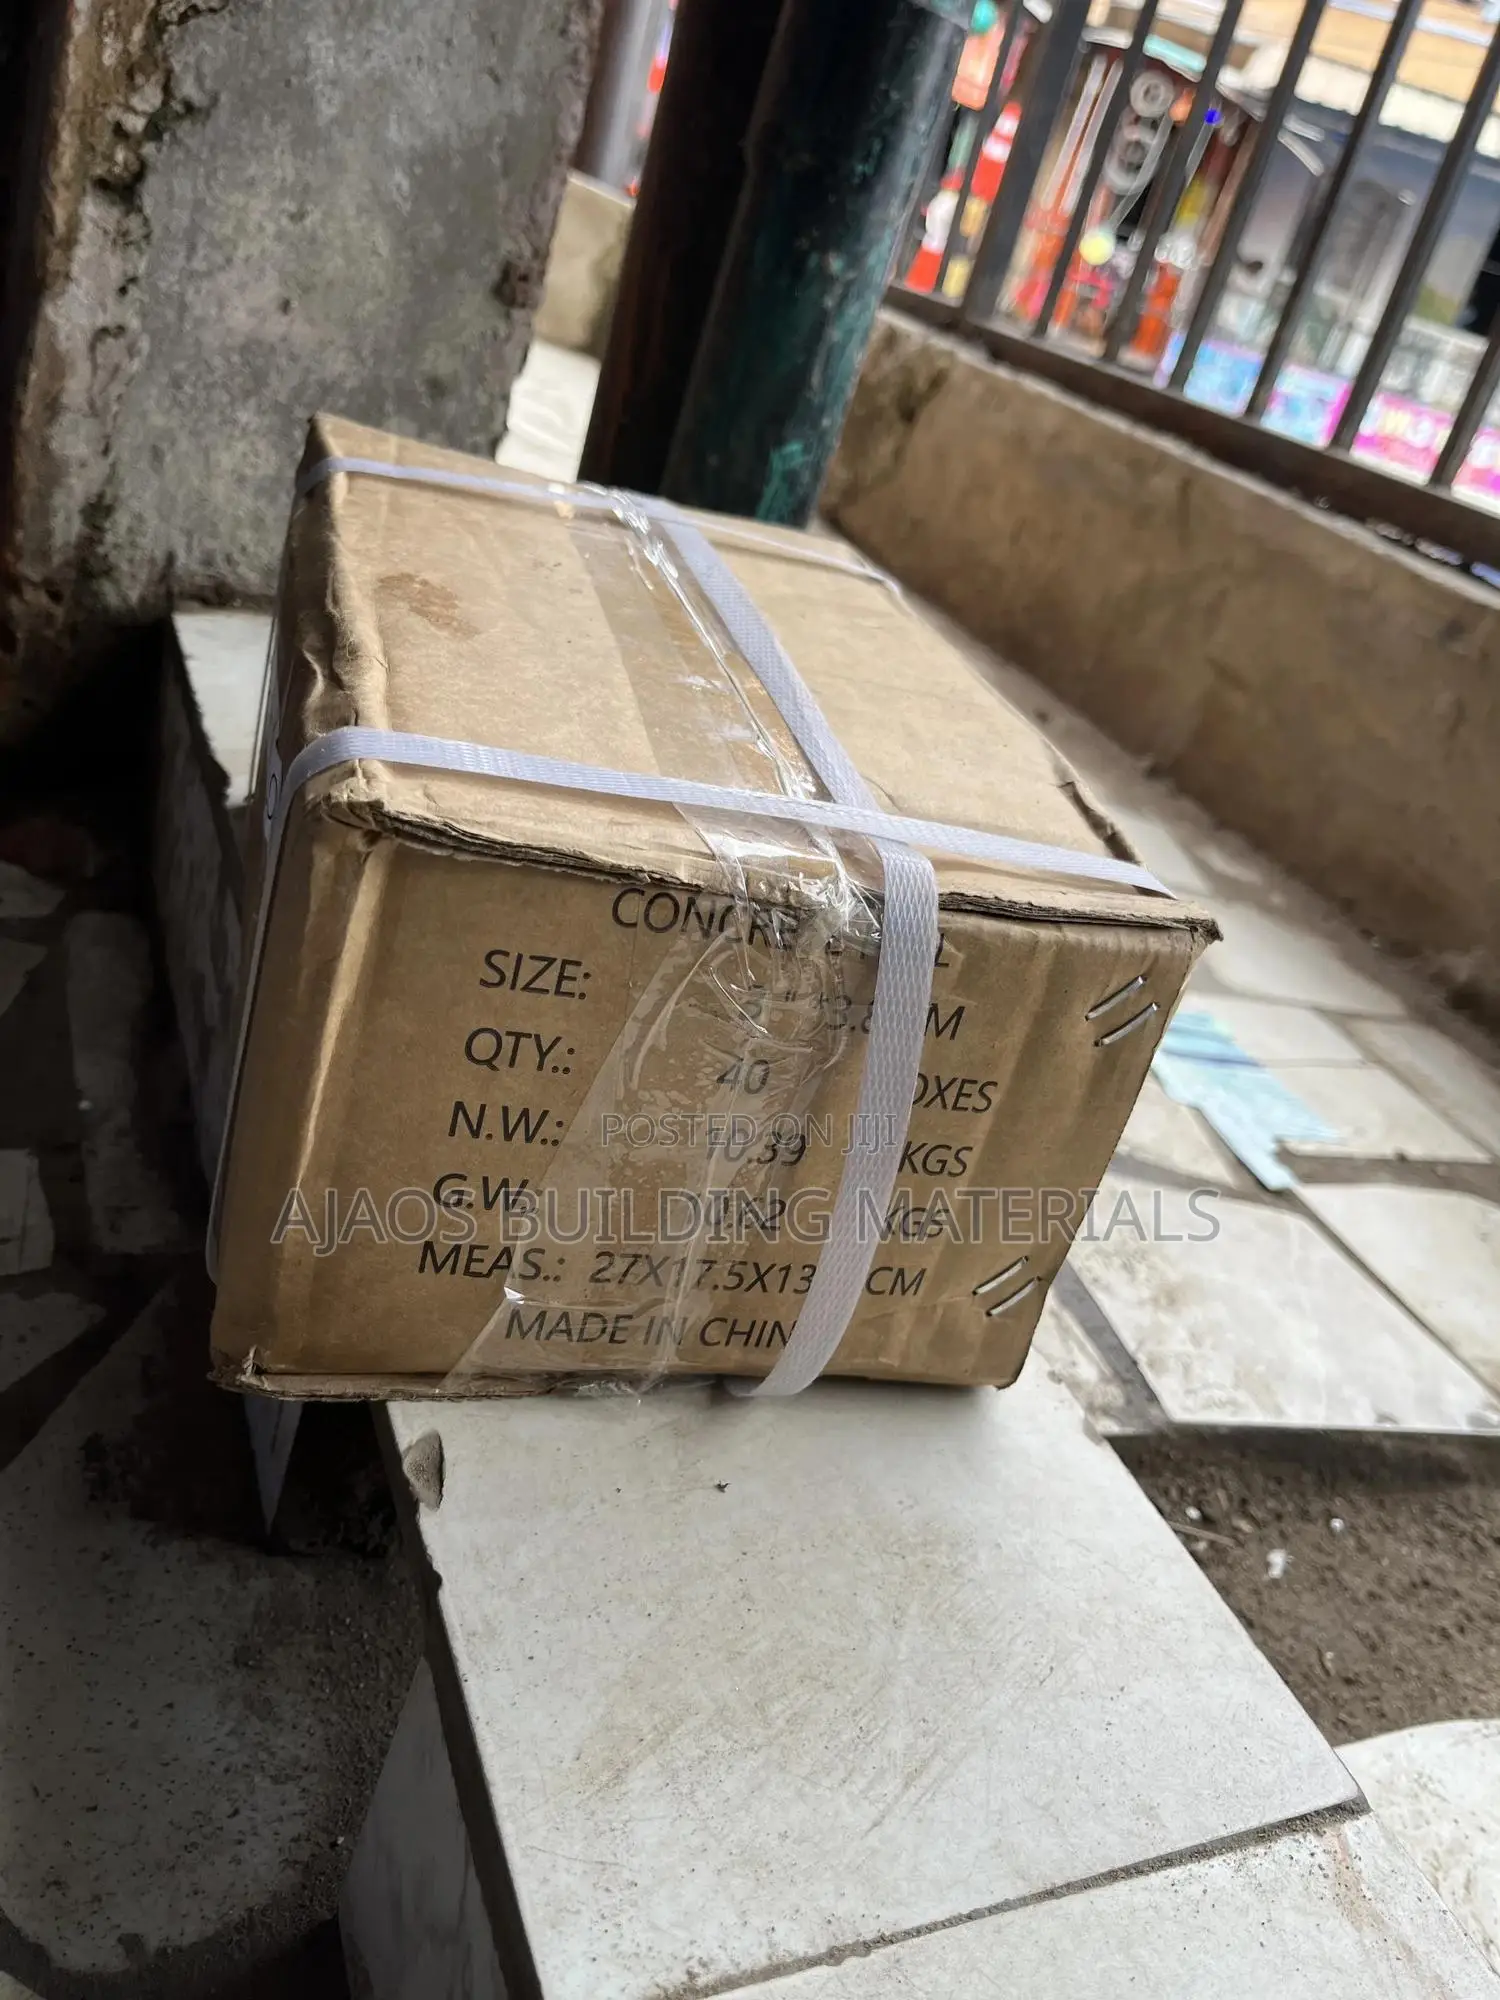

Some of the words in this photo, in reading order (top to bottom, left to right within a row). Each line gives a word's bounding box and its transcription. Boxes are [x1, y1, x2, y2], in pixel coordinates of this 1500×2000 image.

[479, 949, 592, 1000] SIZE:
[464, 1027, 576, 1075] QTY.:
[716, 1058, 770, 1095] 40
[448, 1100, 564, 1147] N.W.:
[898, 1141, 973, 1177] KGS
[417, 1240, 566, 1283] MEAS.:
[865, 1266, 926, 1297] CM
[504, 1309, 634, 1345] MADE
[699, 1316, 797, 1348] CHIN
